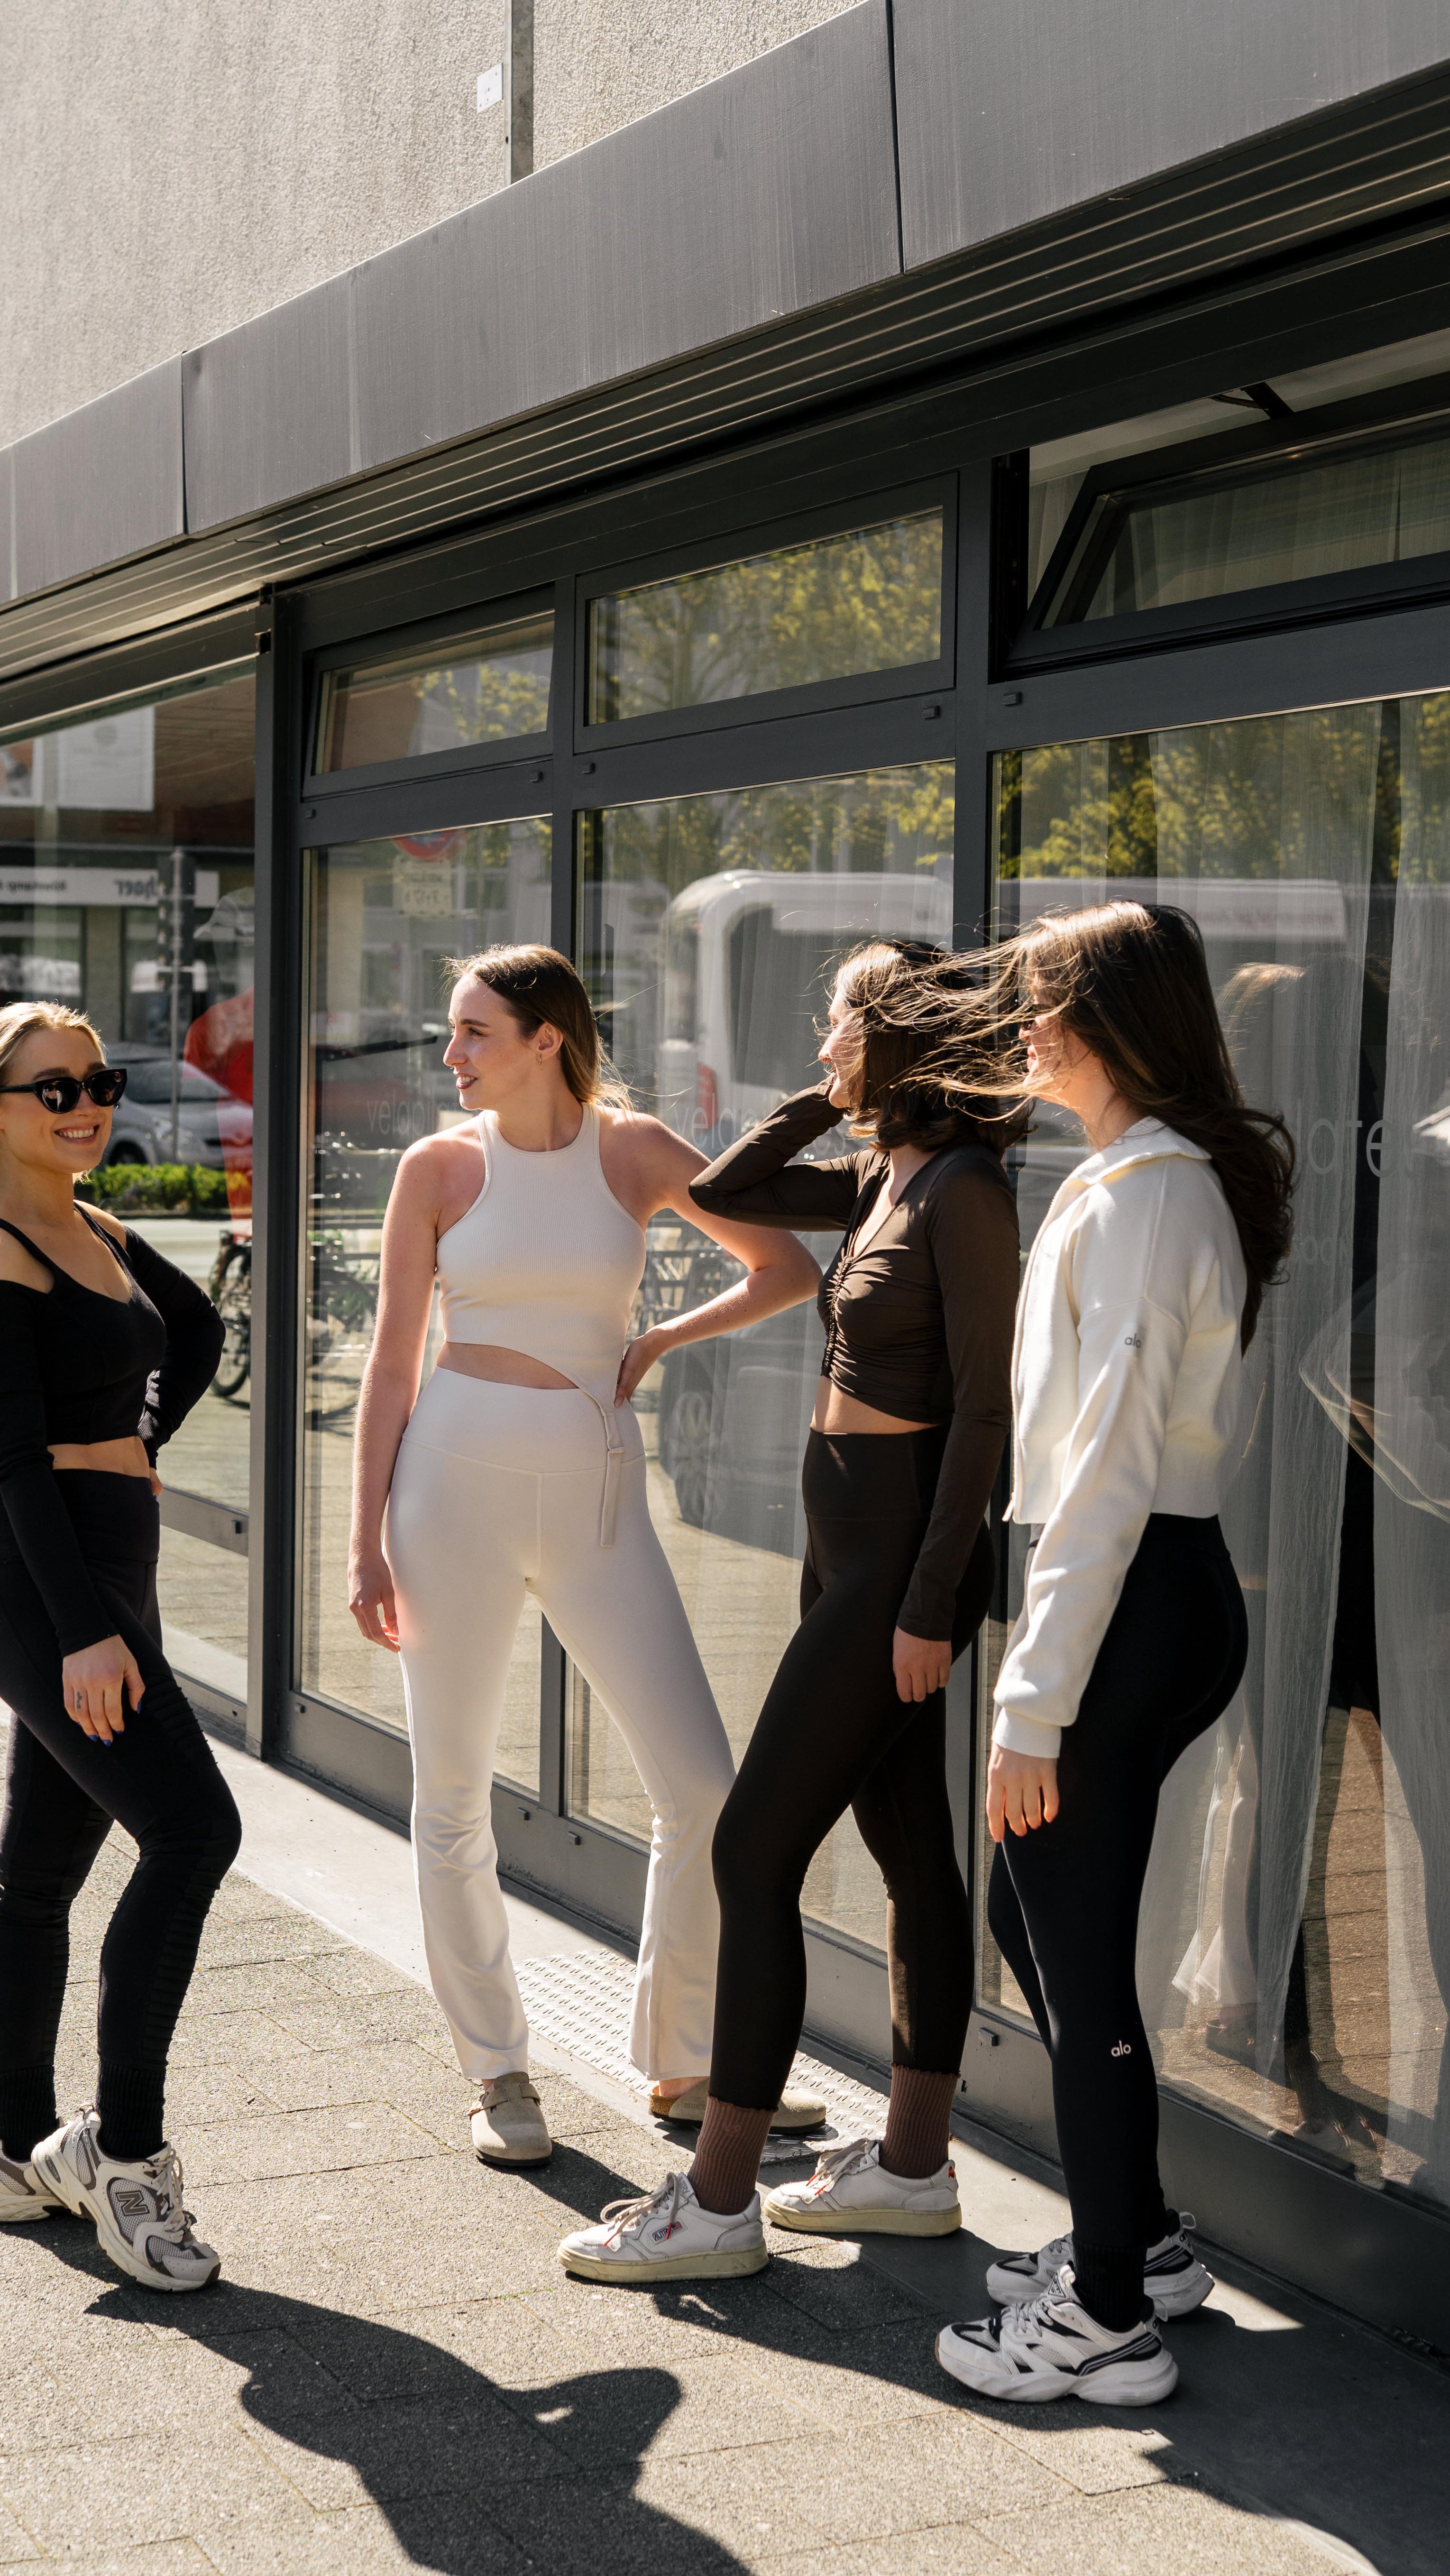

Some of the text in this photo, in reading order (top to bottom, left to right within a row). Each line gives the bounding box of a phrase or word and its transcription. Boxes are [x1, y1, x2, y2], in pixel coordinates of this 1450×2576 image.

[1125, 1333, 1141, 1348] alo
[1111, 2040, 1131, 2057] alo
[116, 2190, 150, 2216] N
